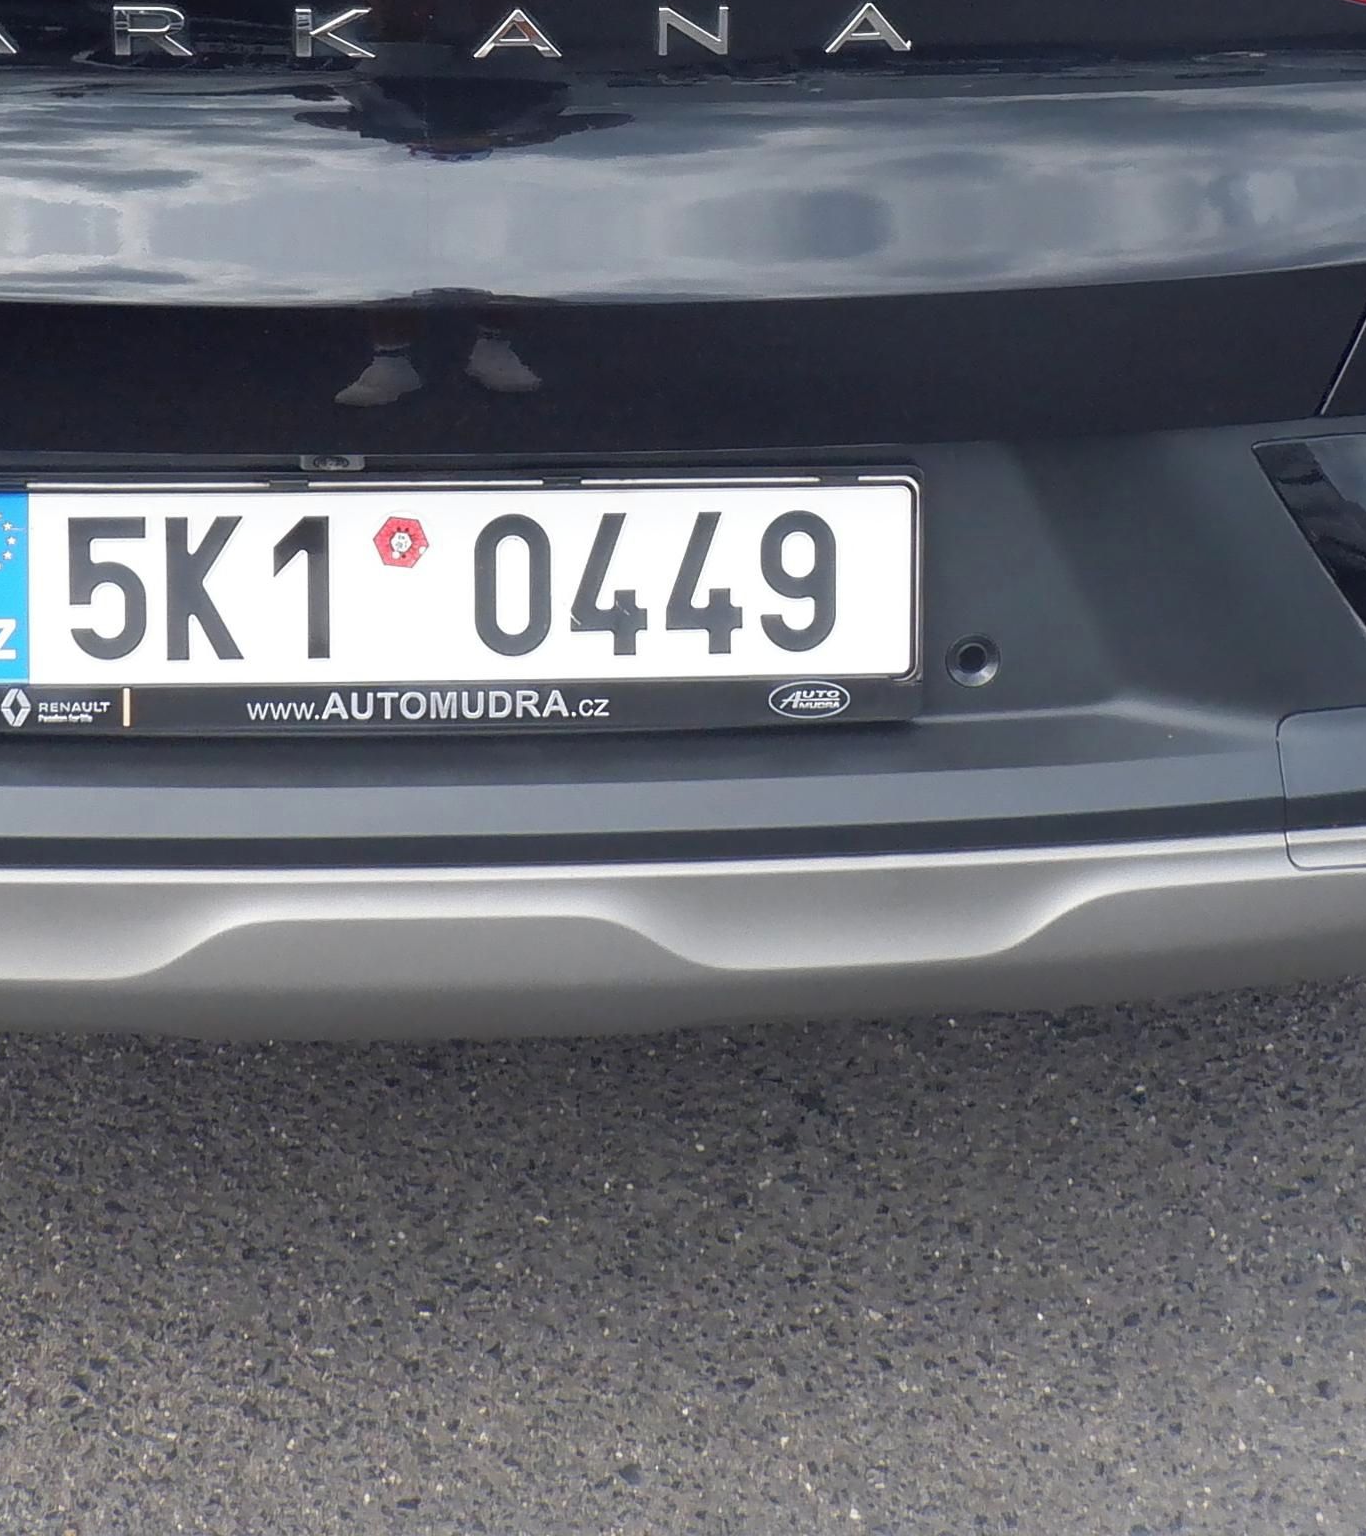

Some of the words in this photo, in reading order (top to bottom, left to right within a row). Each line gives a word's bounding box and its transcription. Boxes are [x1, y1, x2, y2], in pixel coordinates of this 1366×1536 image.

[68, 515, 331, 661] 5K1
[474, 510, 836, 657] 0449
[38, 701, 111, 713] RENAULT
[246, 690, 610, 721] www.AUTOMUDRA.cz
[779, 690, 841, 710] AUTO
